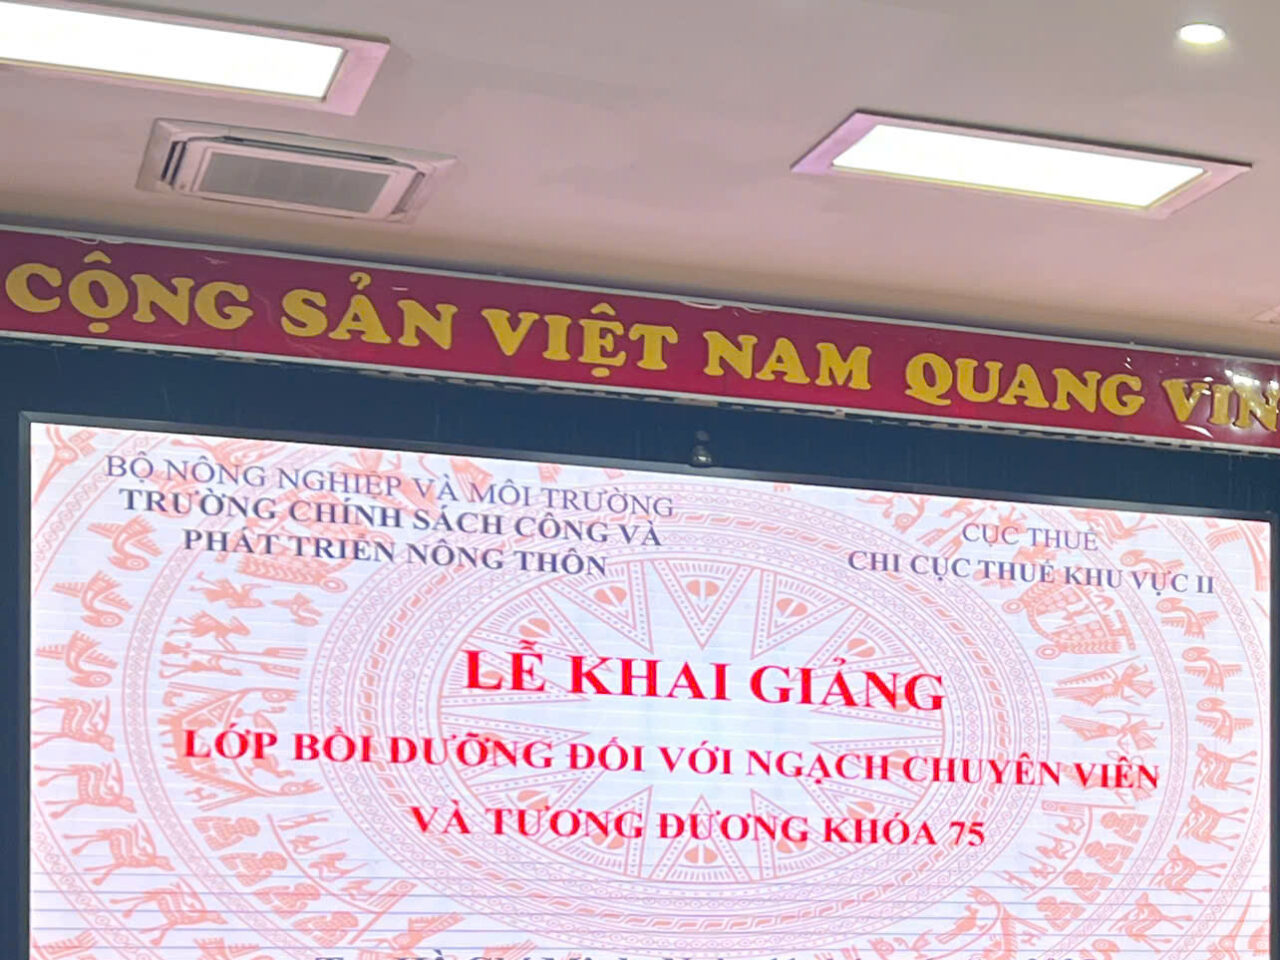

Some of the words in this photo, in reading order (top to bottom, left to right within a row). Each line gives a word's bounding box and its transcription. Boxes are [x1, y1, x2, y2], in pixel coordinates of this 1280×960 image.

[5, 250, 254, 334] CỘNG
[280, 271, 458, 350] SẢN
[481, 303, 679, 378] VIỆT
[703, 330, 872, 391] NAM
[905, 352, 1145, 416] QUANG
[106, 451, 154, 484] BỘ
[164, 455, 266, 488] NÔNG
[412, 474, 459, 502] VÀ
[469, 479, 532, 507] MÔI
[541, 487, 674, 518] TRƯỜNG
[119, 488, 277, 521] TRƯỜNG
[288, 497, 405, 529] CHÍNH
[412, 504, 504, 535] SÁCH
[514, 512, 610, 544] CÔNG
[617, 520, 663, 547] VÀ
[962, 522, 1020, 548] CỤC
[183, 526, 281, 555] PHÁT
[407, 539, 506, 570] NÔNG
[512, 547, 609, 576] THÔN
[848, 550, 902, 573] CHI
[910, 554, 972, 582] CỤC
[1063, 566, 1124, 589] KHU
[1129, 570, 1189, 597] VỰC
[1195, 575, 1216, 594] II
[463, 639, 546, 692] LỄ
[567, 654, 733, 701] KHAI
[749, 657, 946, 711] GIẢNG
[183, 721, 279, 760] LỚP
[292, 726, 374, 764] BỒI
[389, 732, 554, 770] DƯỠNG
[566, 736, 647, 773] ĐỐI
[657, 741, 734, 776] VỚI
[745, 748, 890, 785] NGẠCH
[902, 753, 1064, 787] CHUYÊN
[1072, 757, 1160, 790] VIÊN
[410, 800, 471, 835] VÀ
[485, 805, 645, 840] TƯƠNG
[656, 809, 810, 843] ĐƯƠNG
[823, 813, 938, 846] KHÓA
[949, 820, 986, 847] 75
